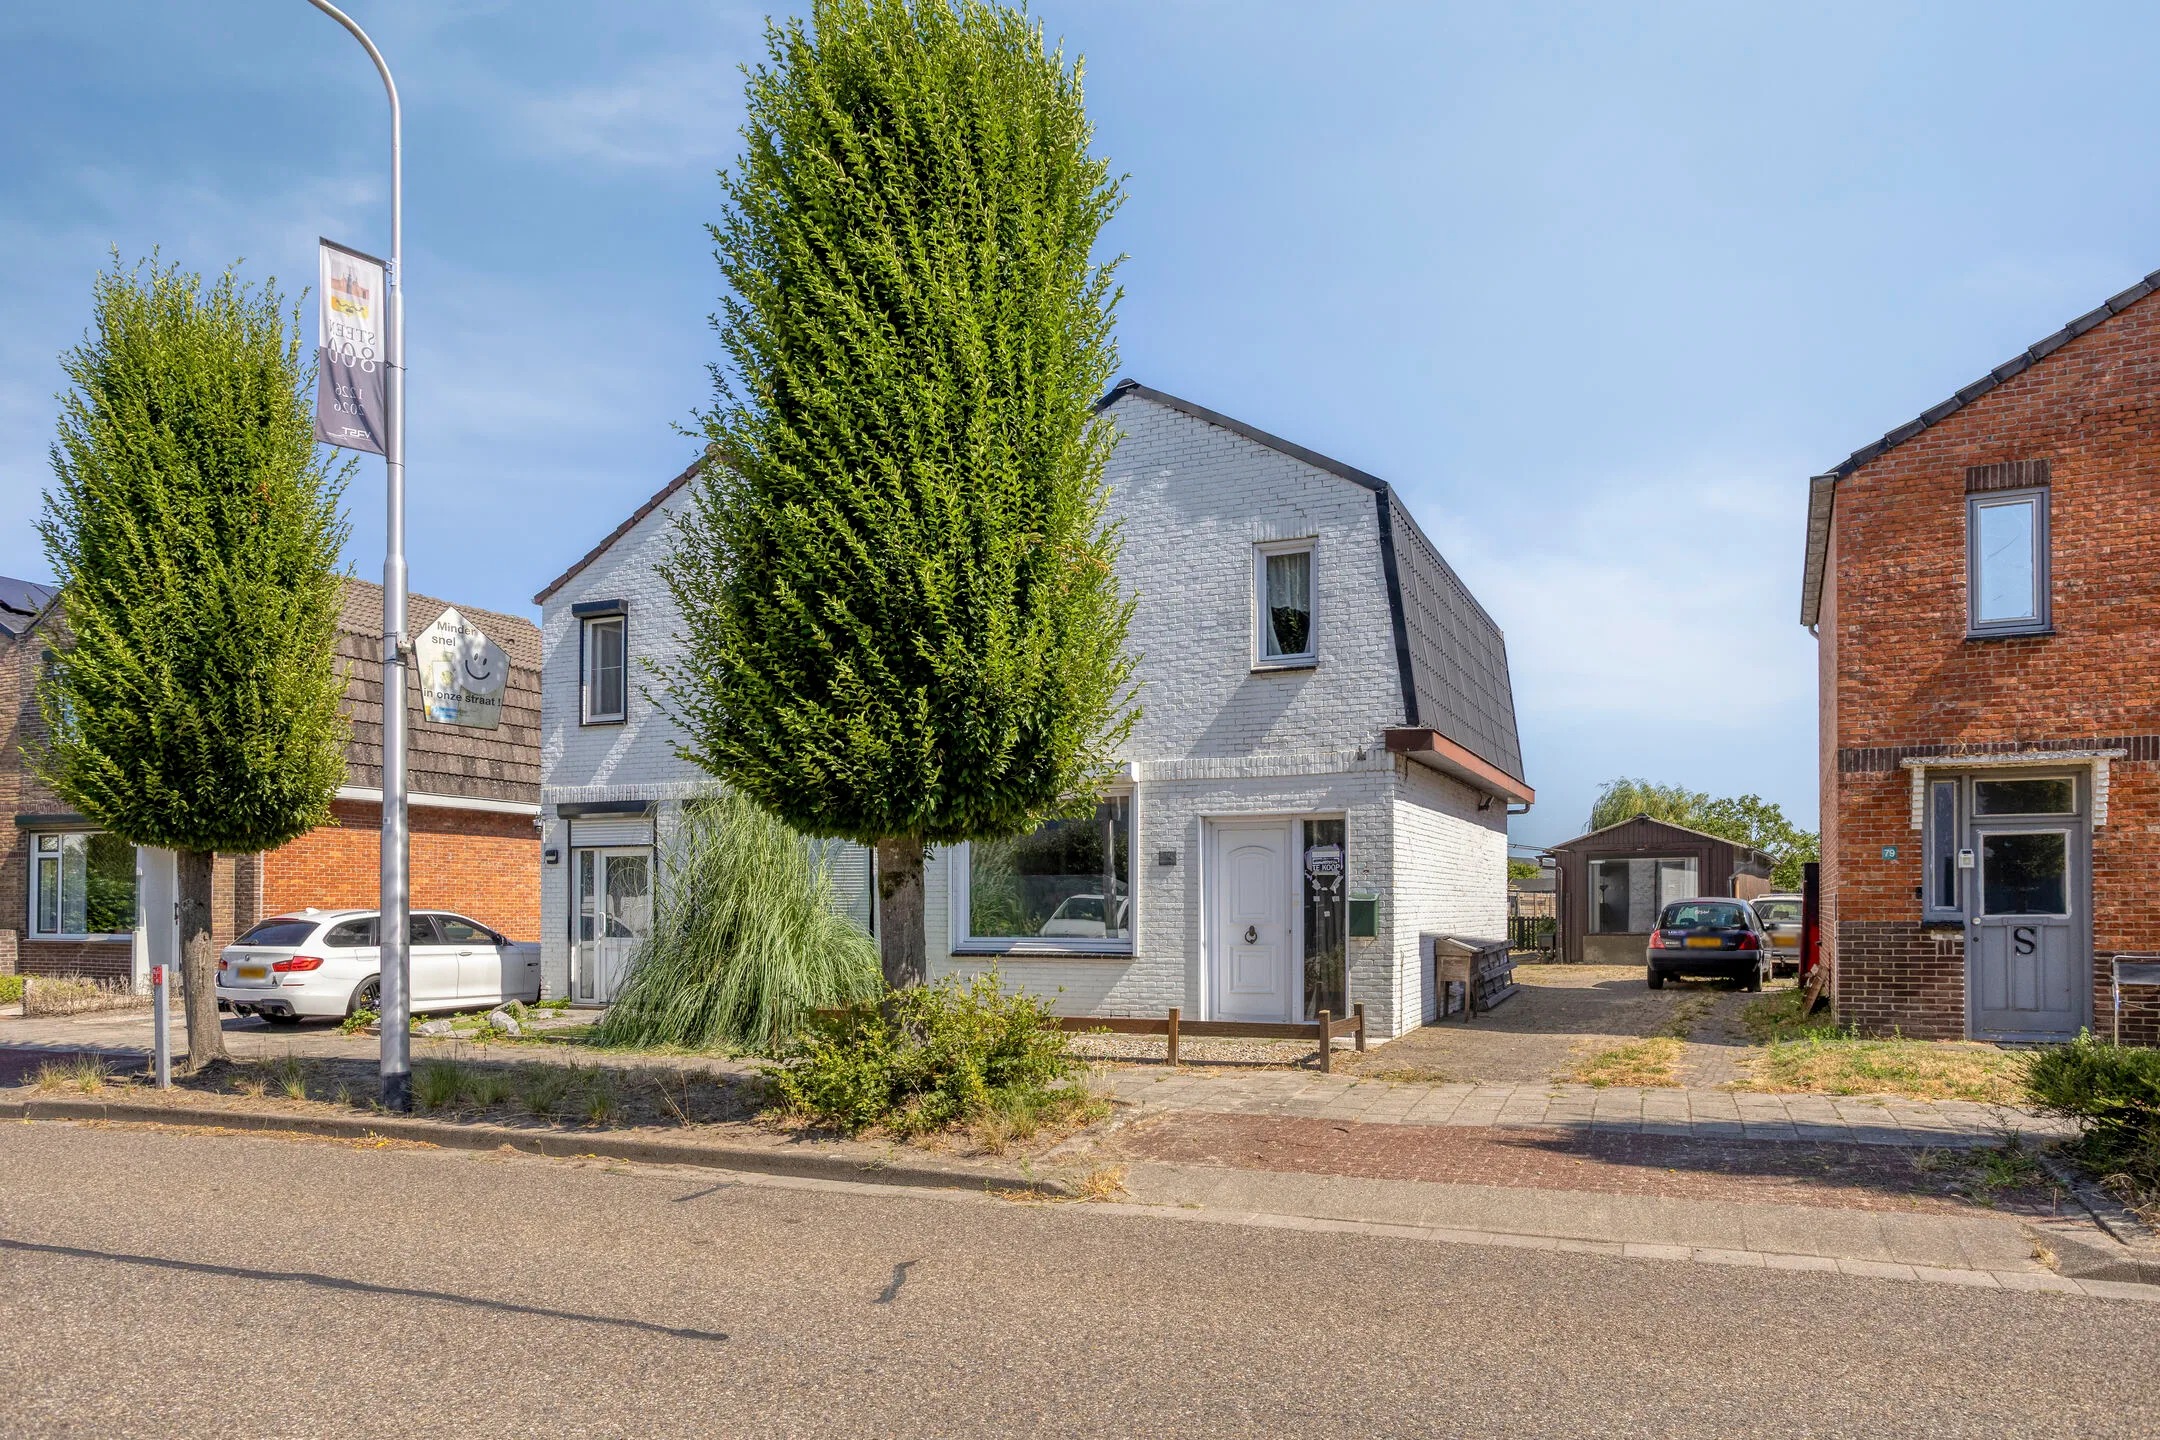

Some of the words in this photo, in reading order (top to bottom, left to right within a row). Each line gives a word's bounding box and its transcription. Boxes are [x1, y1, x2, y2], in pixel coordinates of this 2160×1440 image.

[437, 621, 477, 636] Minder
[431, 635, 456, 646] snel
[423, 688, 433, 697] in
[437, 691, 462, 702] onze
[465, 693, 496, 706] straat
[1884, 849, 1896, 858] 79
[2013, 926, 2036, 955] S
